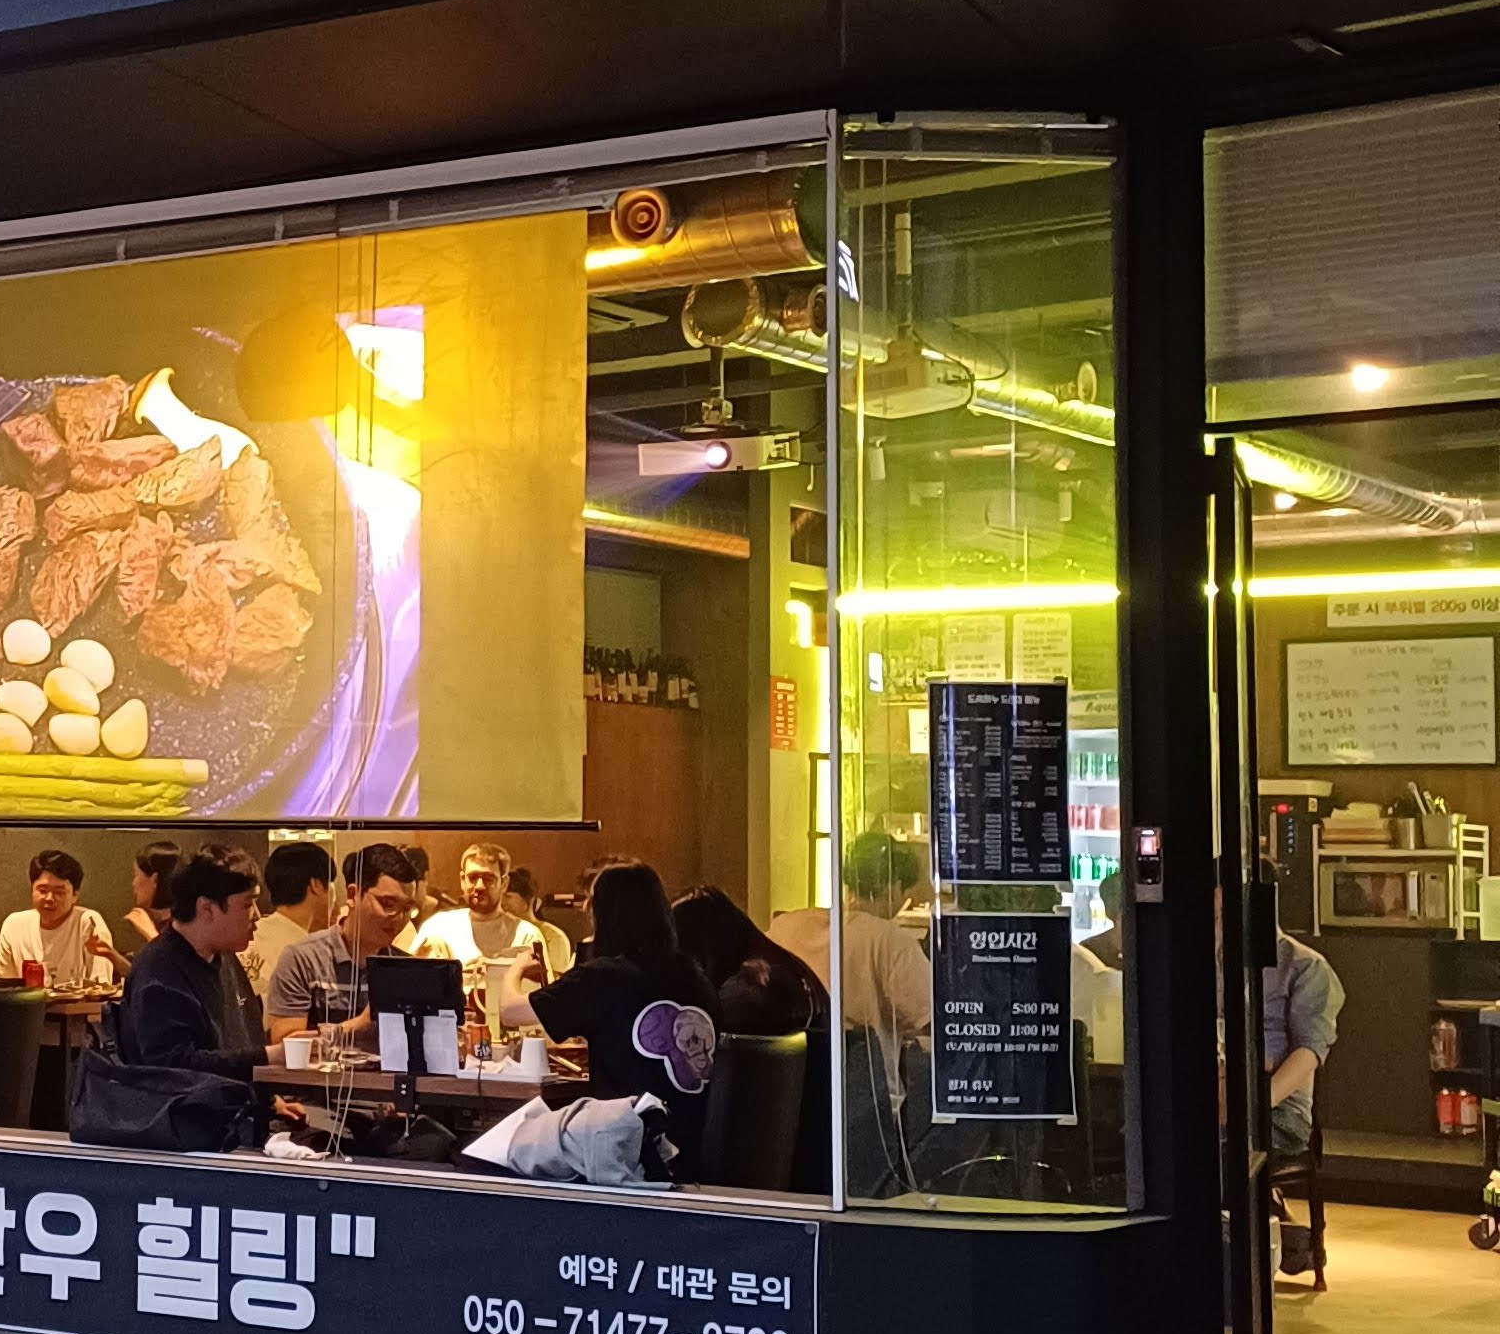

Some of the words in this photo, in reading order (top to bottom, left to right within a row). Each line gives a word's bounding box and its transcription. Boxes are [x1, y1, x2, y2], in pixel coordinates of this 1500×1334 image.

[1365, 602, 1379, 615] 시
[1430, 598, 1467, 613] 200g
[945, 1001, 984, 1014] OPEN
[1012, 1003, 1038, 1015] 5:00
[1041, 1003, 1059, 1015] PM
[945, 1023, 1000, 1036] CLOSED
[1010, 1024, 1038, 1036] 11:00
[1041, 1024, 1060, 1036] PM
[135, 1195, 377, 1333] 힐링"
[558, 1254, 618, 1290] 예약
[656, 1264, 718, 1301] 대관
[727, 1271, 792, 1310] 문의
